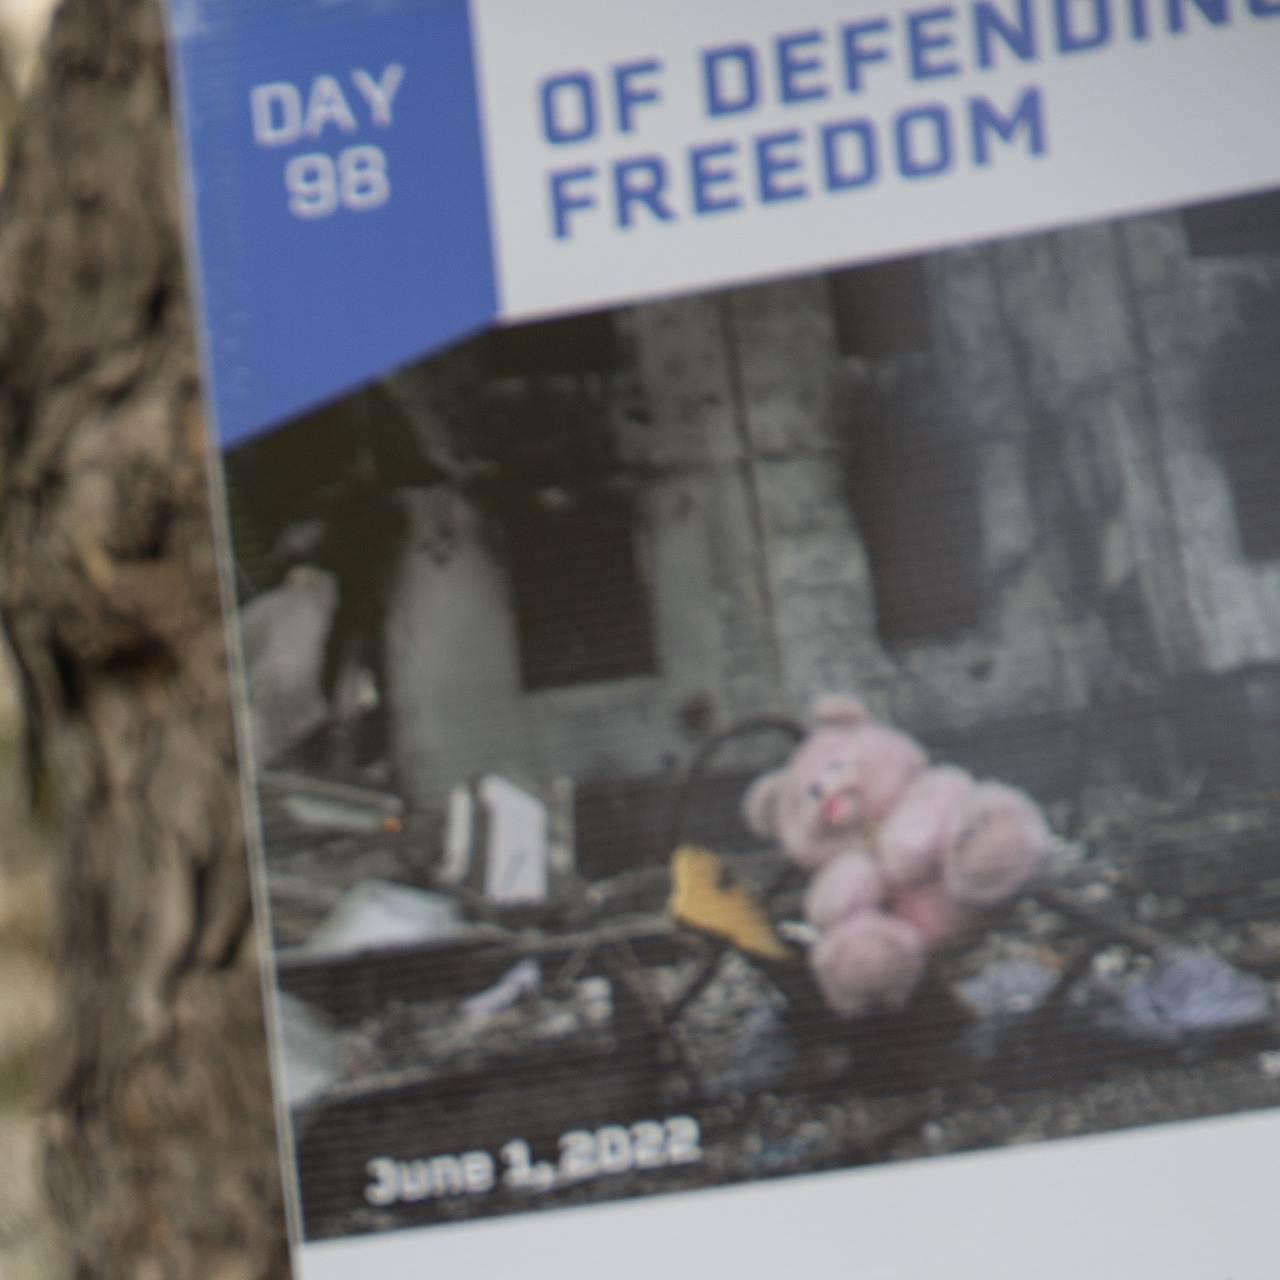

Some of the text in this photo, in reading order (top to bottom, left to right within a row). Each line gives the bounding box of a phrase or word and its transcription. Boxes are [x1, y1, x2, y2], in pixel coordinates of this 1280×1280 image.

[252, 63, 404, 146] DAY
[539, 0, 1280, 147] OF DEFENDI
[286, 144, 390, 219] 98
[548, 85, 1050, 240] FREEDOM
[366, 1117, 701, 1204] June 1, 2022
